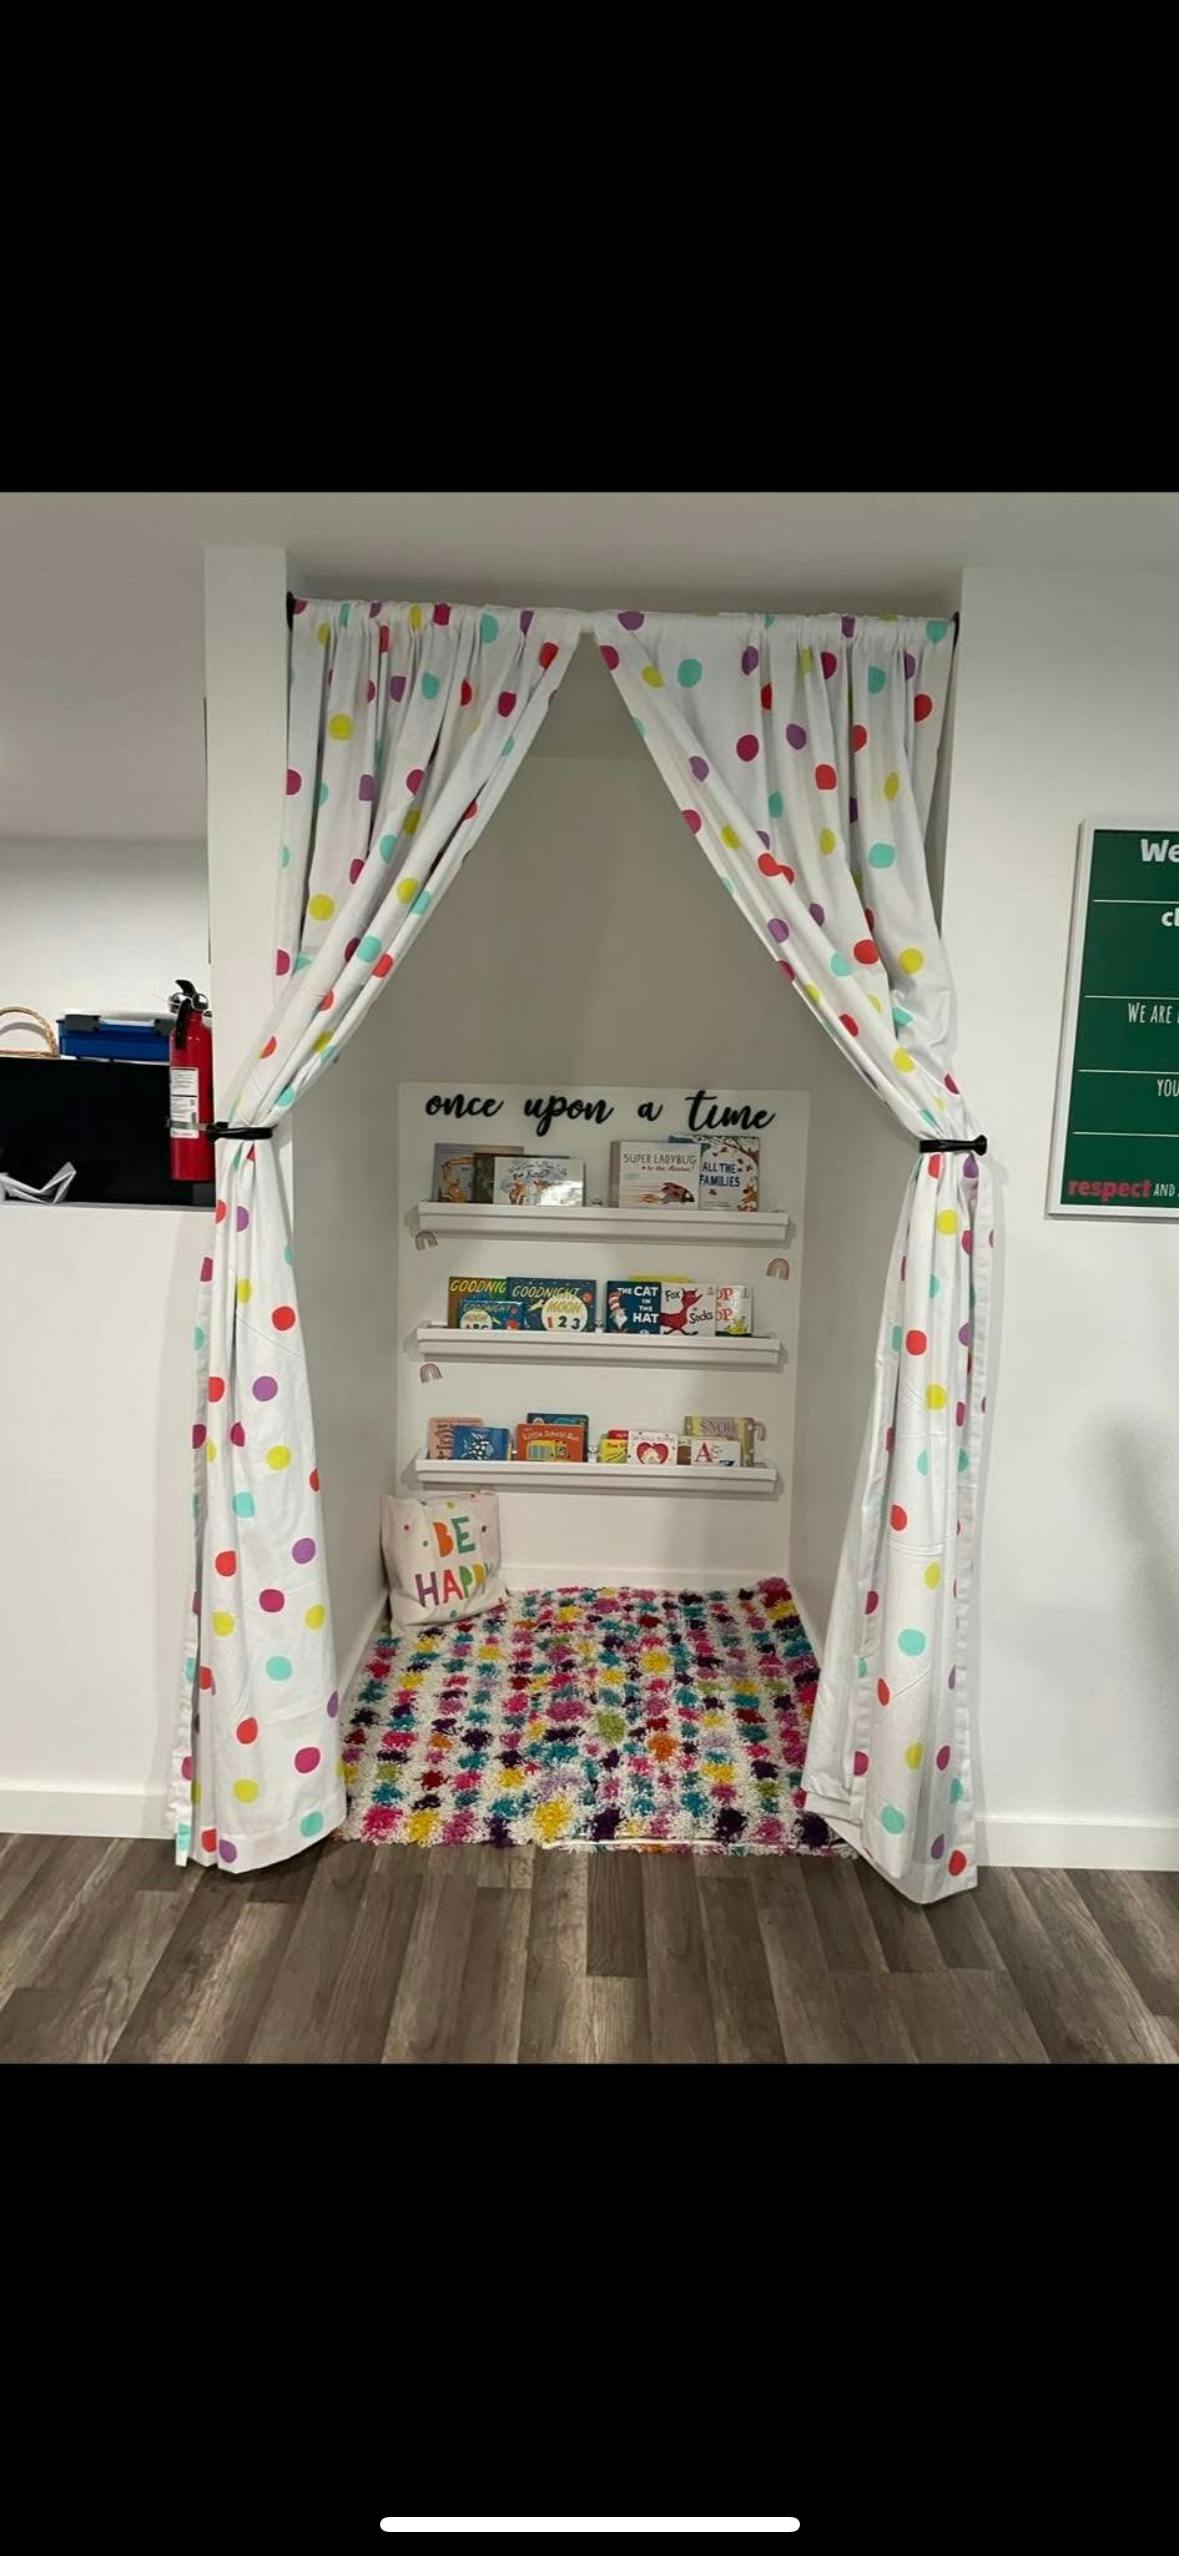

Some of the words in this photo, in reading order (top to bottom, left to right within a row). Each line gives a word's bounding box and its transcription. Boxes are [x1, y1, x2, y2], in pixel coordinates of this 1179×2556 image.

[1141, 839, 1179, 864] We
[1150, 1005, 1173, 1024] ARE
[425, 1093, 503, 1118] once
[524, 1094, 614, 1137] upon
[637, 1099, 663, 1122] a
[685, 1090, 775, 1131] time
[623, 1153, 651, 1164] SUPER
[654, 1154, 697, 1165] LADYBUG
[703, 1162, 718, 1172] ALL
[720, 1162, 737, 1174] THE
[700, 1174, 740, 1188] FAMILIES
[1068, 1179, 1152, 1203] respect
[1153, 1182, 1176, 1198] AND
[512, 1285, 580, 1299] GOODNIGHT
[617, 1287, 632, 1295] THE
[633, 1286, 659, 1297] CAT
[664, 1290, 680, 1303] Fox
[558, 1315, 568, 1328] 2
[571, 1317, 581, 1330] 3
[633, 1312, 660, 1324] HAT
[689, 1310, 714, 1325] Socks
[694, 1442, 713, 1462] A
[432, 1516, 476, 1557] BE
